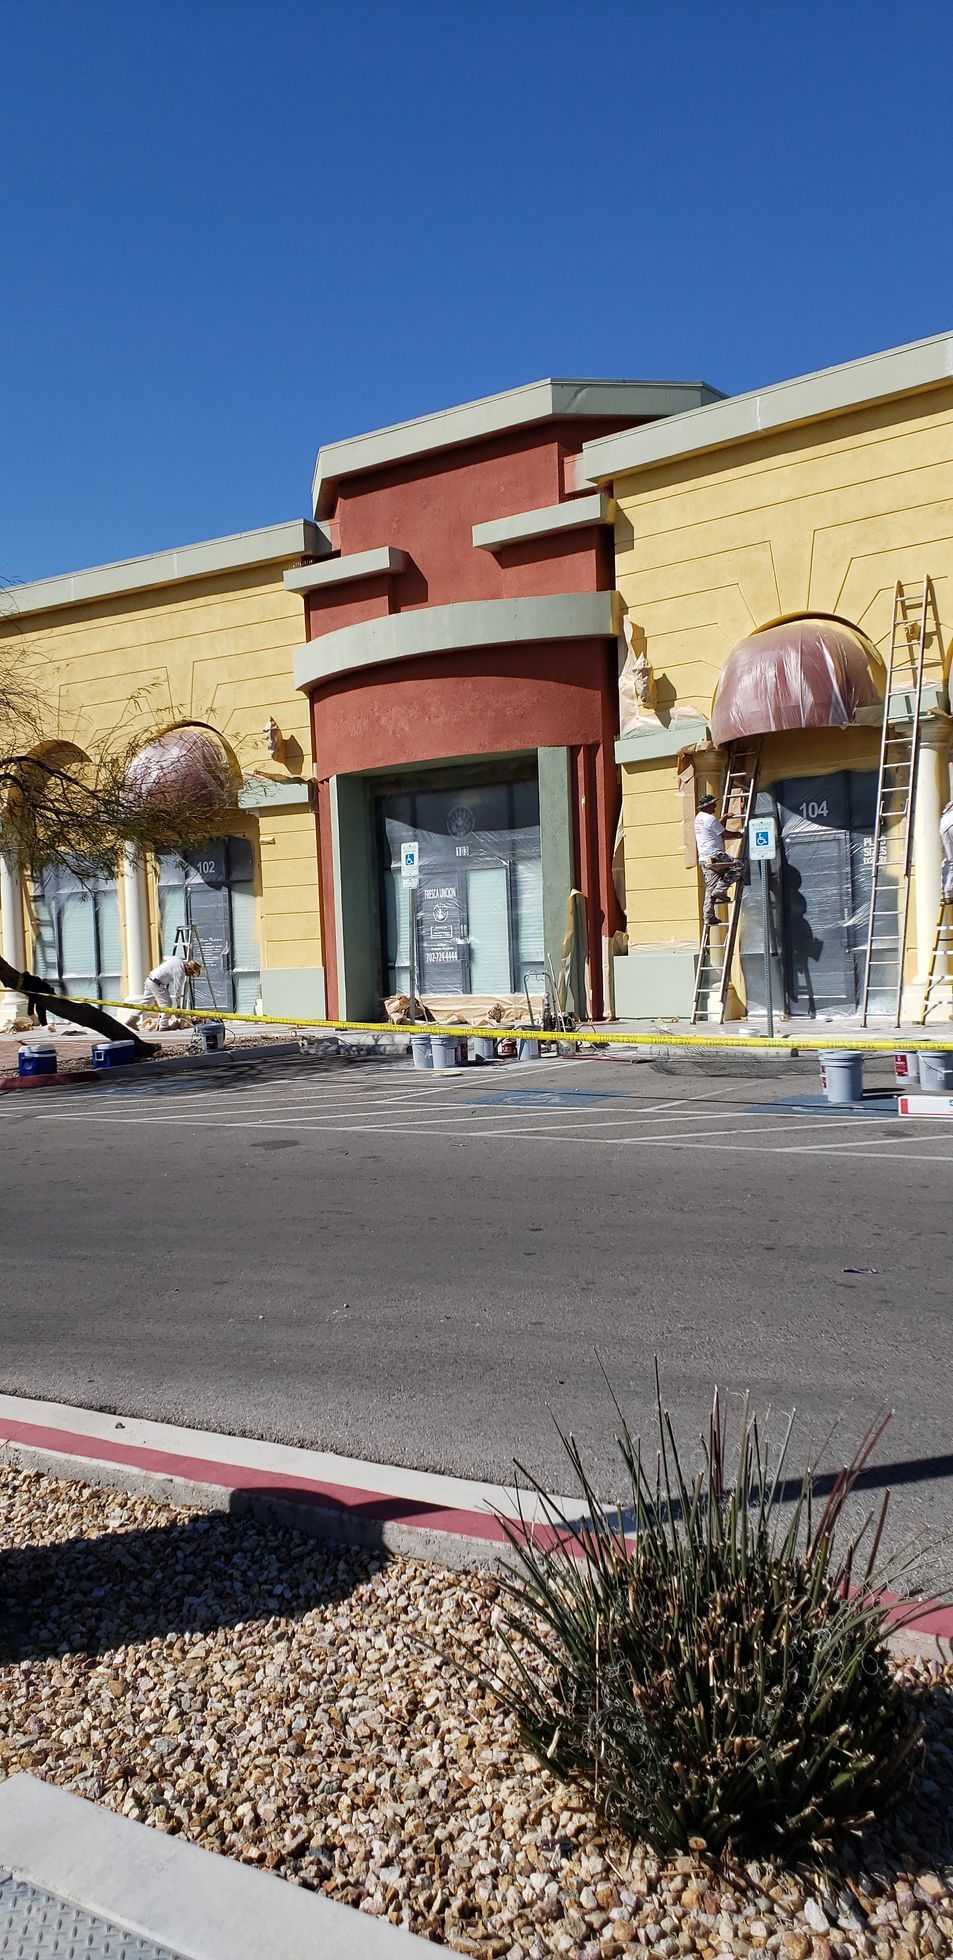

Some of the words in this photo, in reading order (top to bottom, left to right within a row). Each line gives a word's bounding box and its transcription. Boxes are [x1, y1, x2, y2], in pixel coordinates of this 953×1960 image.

[800, 800, 829, 819] 104
[455, 845, 470, 857] 103
[197, 861, 216, 874] 102
